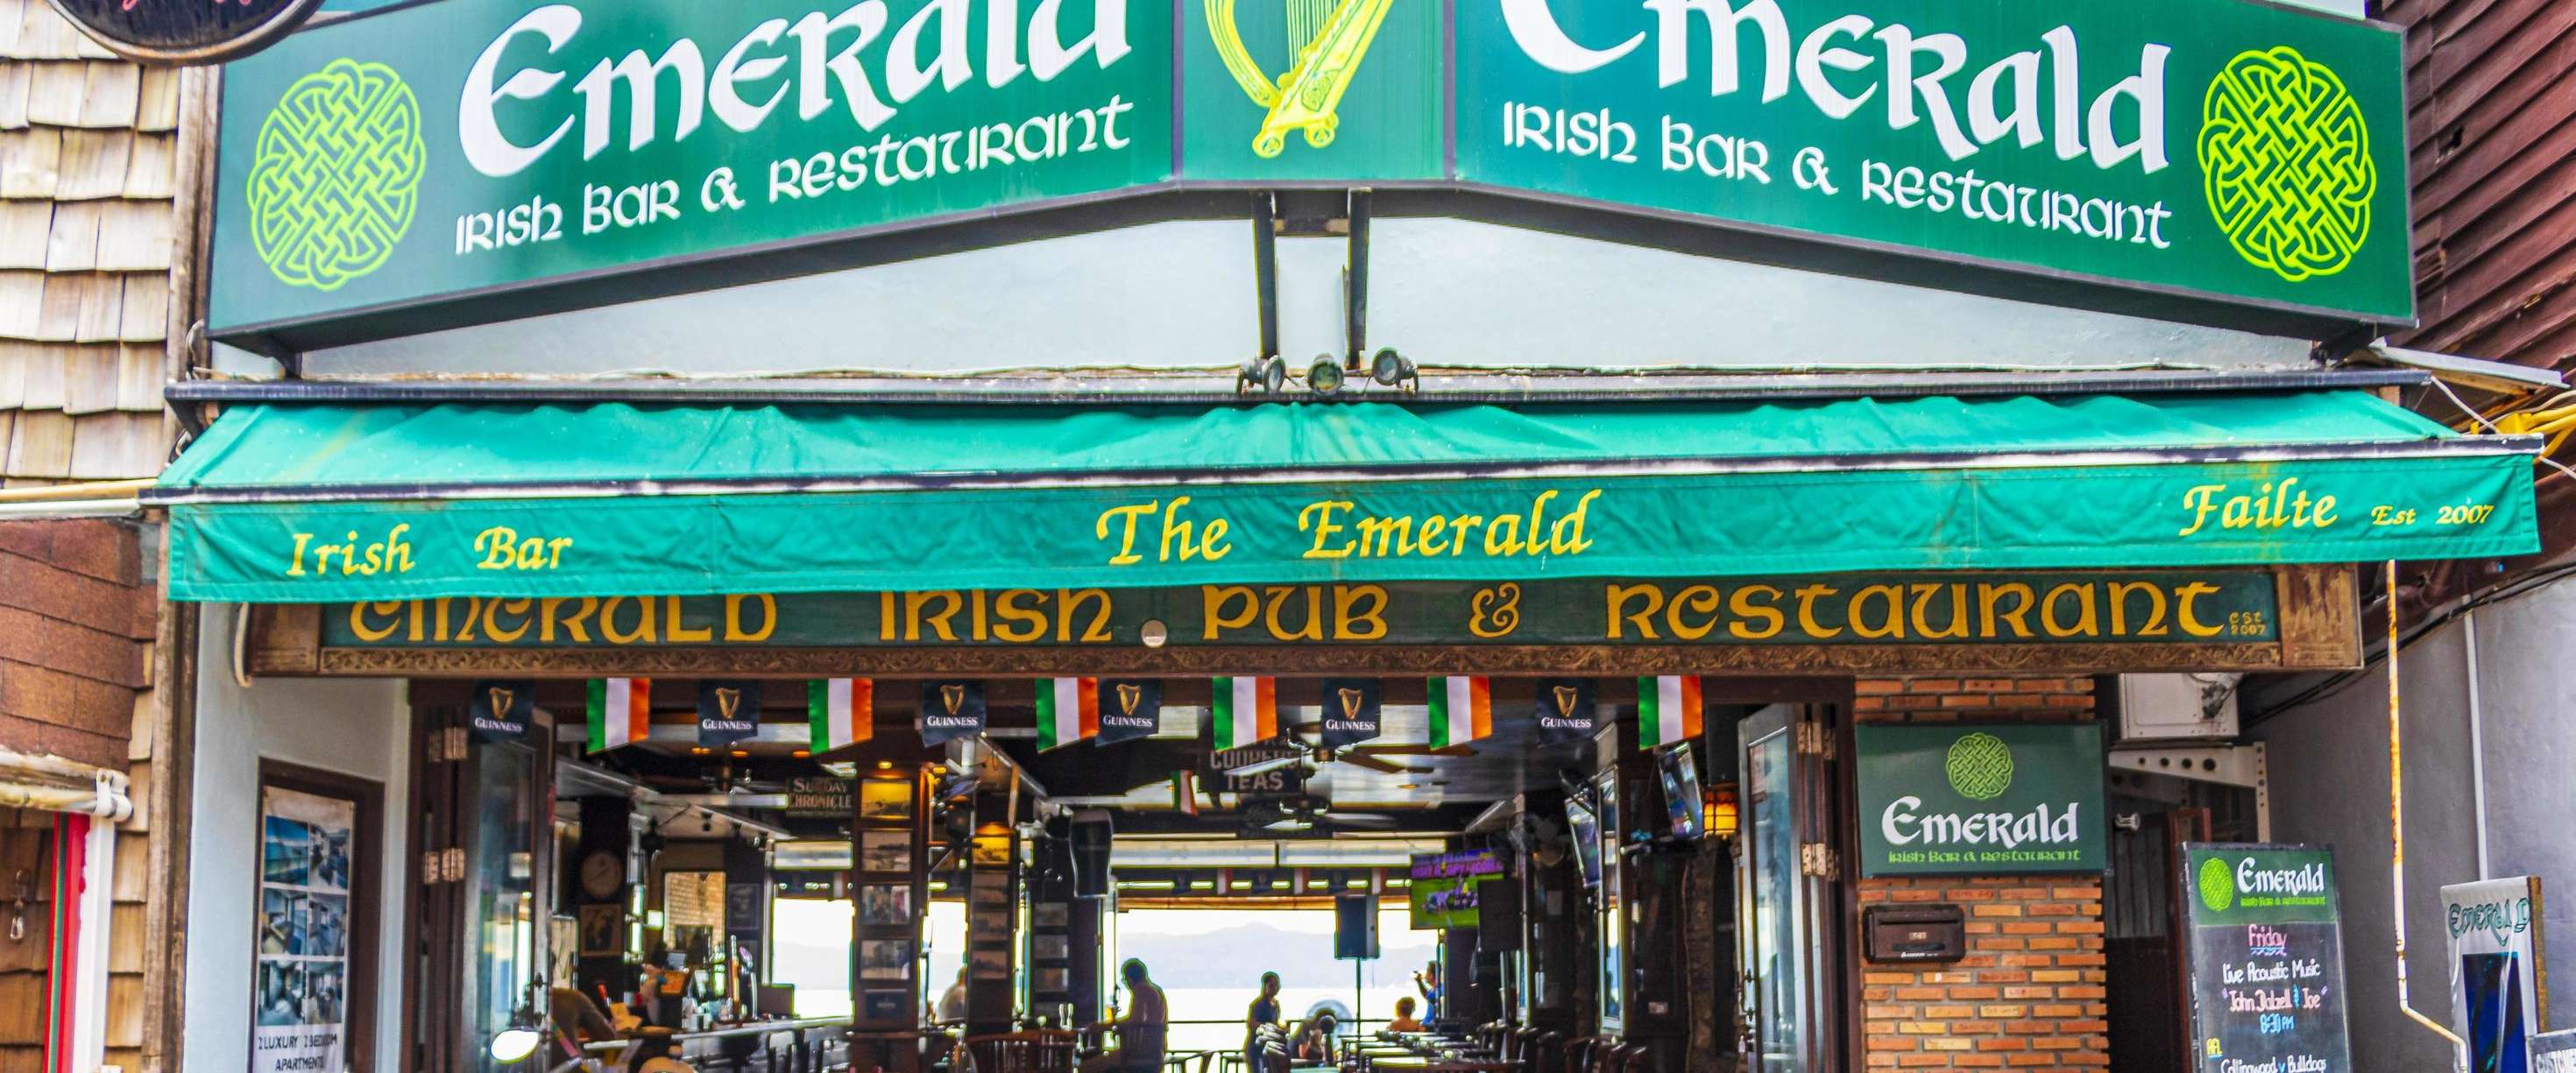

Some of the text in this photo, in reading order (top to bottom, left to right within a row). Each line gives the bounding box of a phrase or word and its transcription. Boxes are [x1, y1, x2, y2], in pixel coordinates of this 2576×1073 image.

[458, 0, 1134, 177] Emerald
[1791, 145, 1838, 195] &
[701, 166, 745, 212] &
[2178, 476, 2338, 538] Failte
[2370, 505, 2494, 526] Est 2007
[1095, 489, 1602, 565] The Emerald
[286, 523, 574, 576] Irish Bar
[1201, 585, 1390, 641] PUB
[1468, 582, 1520, 639] &
[474, 716, 523, 732] GUINNESS
[702, 716, 753, 731] GUINNESS
[926, 713, 979, 727] GUINNESS
[1102, 713, 1154, 729] GUINNESS
[1325, 717, 1376, 731] GUINNESS
[1539, 715, 1592, 729] GUINNESS
[1225, 771, 1284, 791] TEAS
[1881, 795, 2080, 849] Emerald
[1964, 851, 1977, 863] &
[2236, 857, 2325, 895] Emerald
[2248, 923, 2288, 947] Friday
[2222, 957, 2321, 985] Live Acoustic Music
